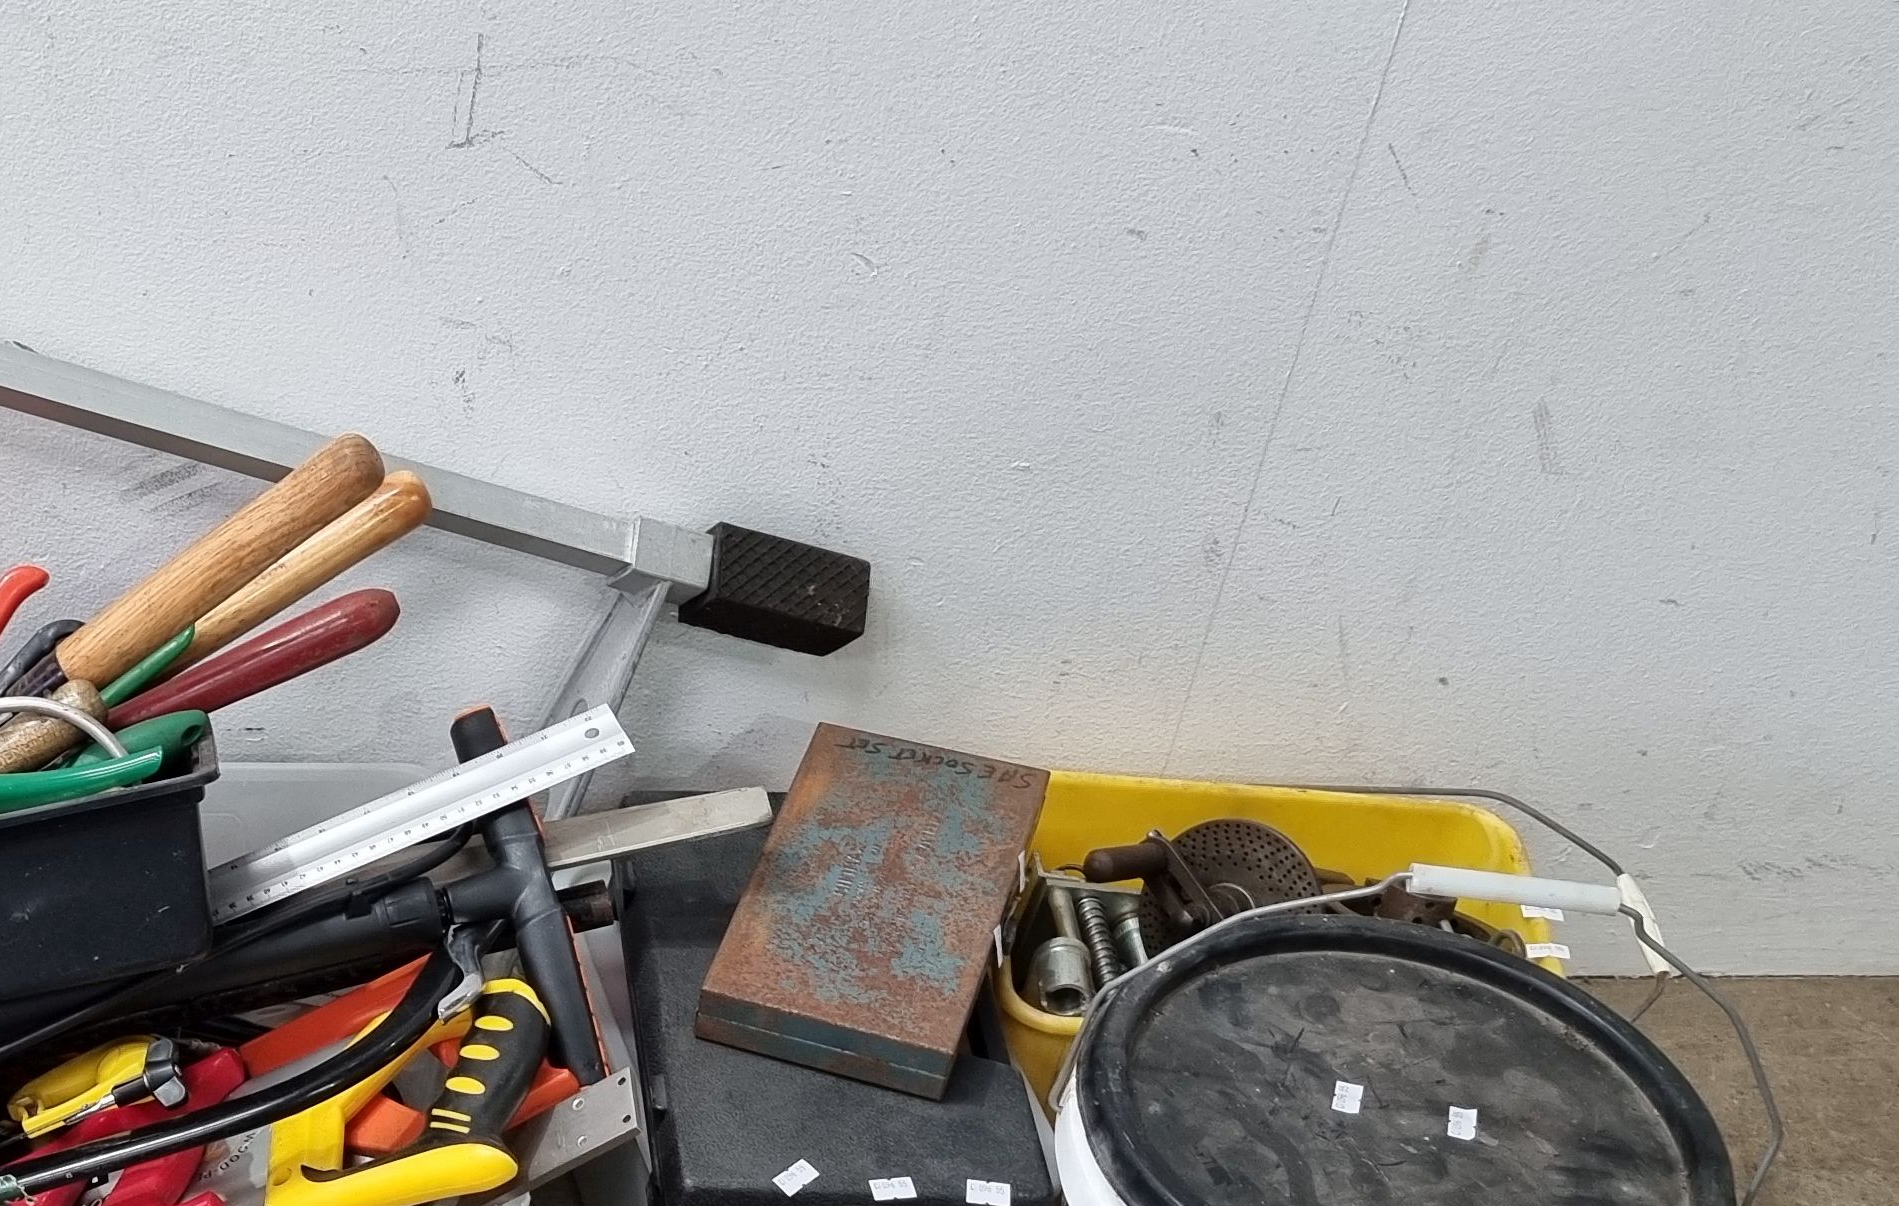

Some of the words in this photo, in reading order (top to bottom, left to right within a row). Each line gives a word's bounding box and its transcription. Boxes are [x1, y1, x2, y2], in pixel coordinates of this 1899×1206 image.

[833, 737, 886, 754] SET
[888, 747, 974, 775] SOCKET
[978, 765, 1034, 789] SAE
